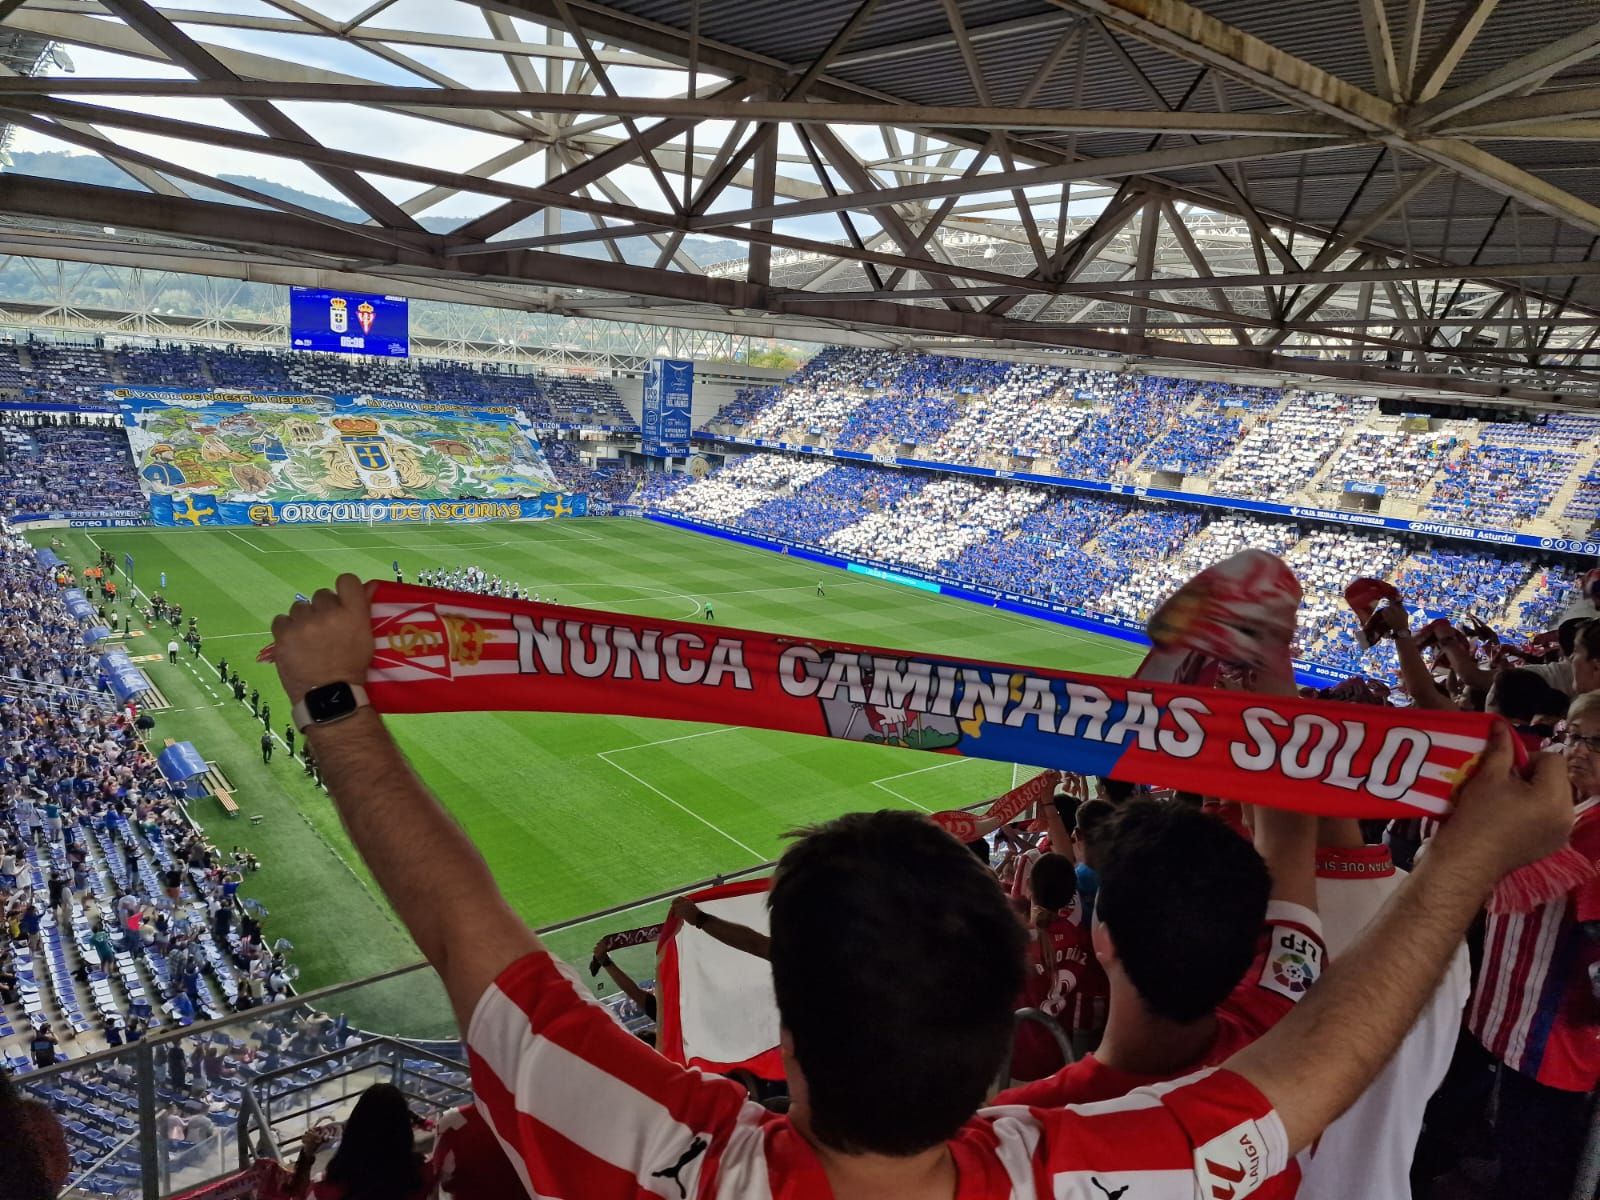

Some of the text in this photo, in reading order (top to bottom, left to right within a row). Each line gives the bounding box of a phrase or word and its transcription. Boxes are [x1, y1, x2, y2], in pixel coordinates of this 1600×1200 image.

[249, 501, 522, 523] EL ORGULLO DE ASTURIAS
[1425, 523, 1517, 544] HYUNDAI Asturdai
[512, 613, 753, 691] NUNCA
[777, 645, 1433, 801] CAMINARAS SOLO
[1342, 862, 1365, 873] QUE
[1280, 933, 1318, 962] LFP
[1239, 1133, 1259, 1188] LALIGA
